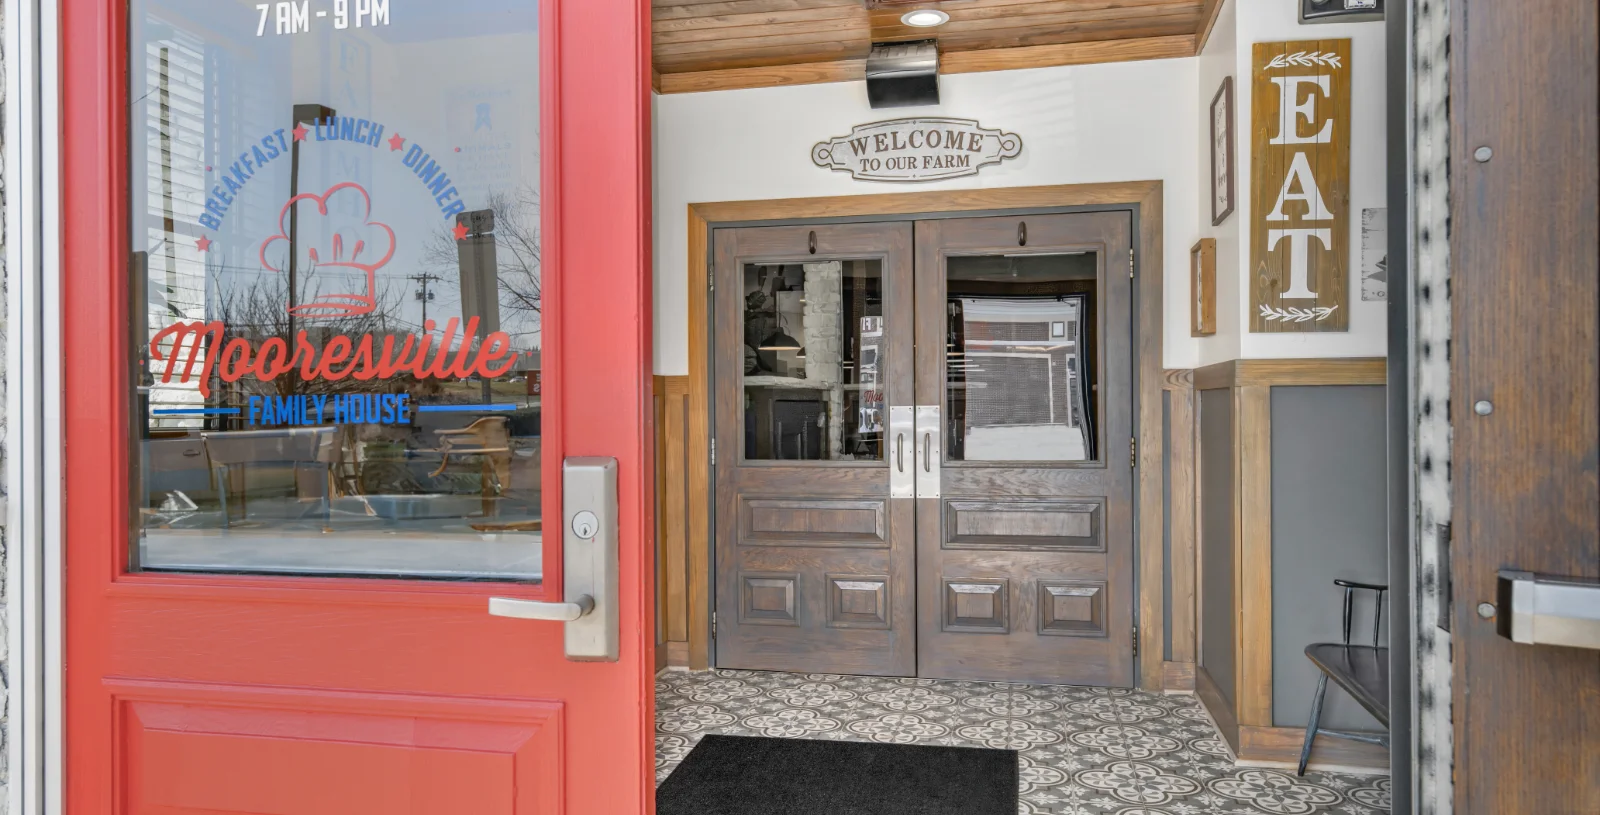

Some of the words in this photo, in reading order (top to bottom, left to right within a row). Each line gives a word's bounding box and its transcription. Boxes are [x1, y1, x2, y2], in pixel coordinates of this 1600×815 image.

[256, 3, 270, 37] 7
[276, 0, 310, 35] AM
[334, 0, 348, 30] 9
[355, 0, 390, 28] PM
[848, 129, 984, 157] WELCOME
[198, 127, 289, 232] BREAKFAST
[313, 116, 385, 148] LUNCH
[401, 143, 465, 220] DINNER
[859, 157, 881, 172] TO
[885, 156, 918, 170] OUR
[923, 154, 970, 169] FARM
[1265, 74, 1334, 299] EAT
[149, 315, 519, 398] Mooresville
[249, 393, 328, 425] FAMILY
[333, 393, 410, 425] HOUSE
